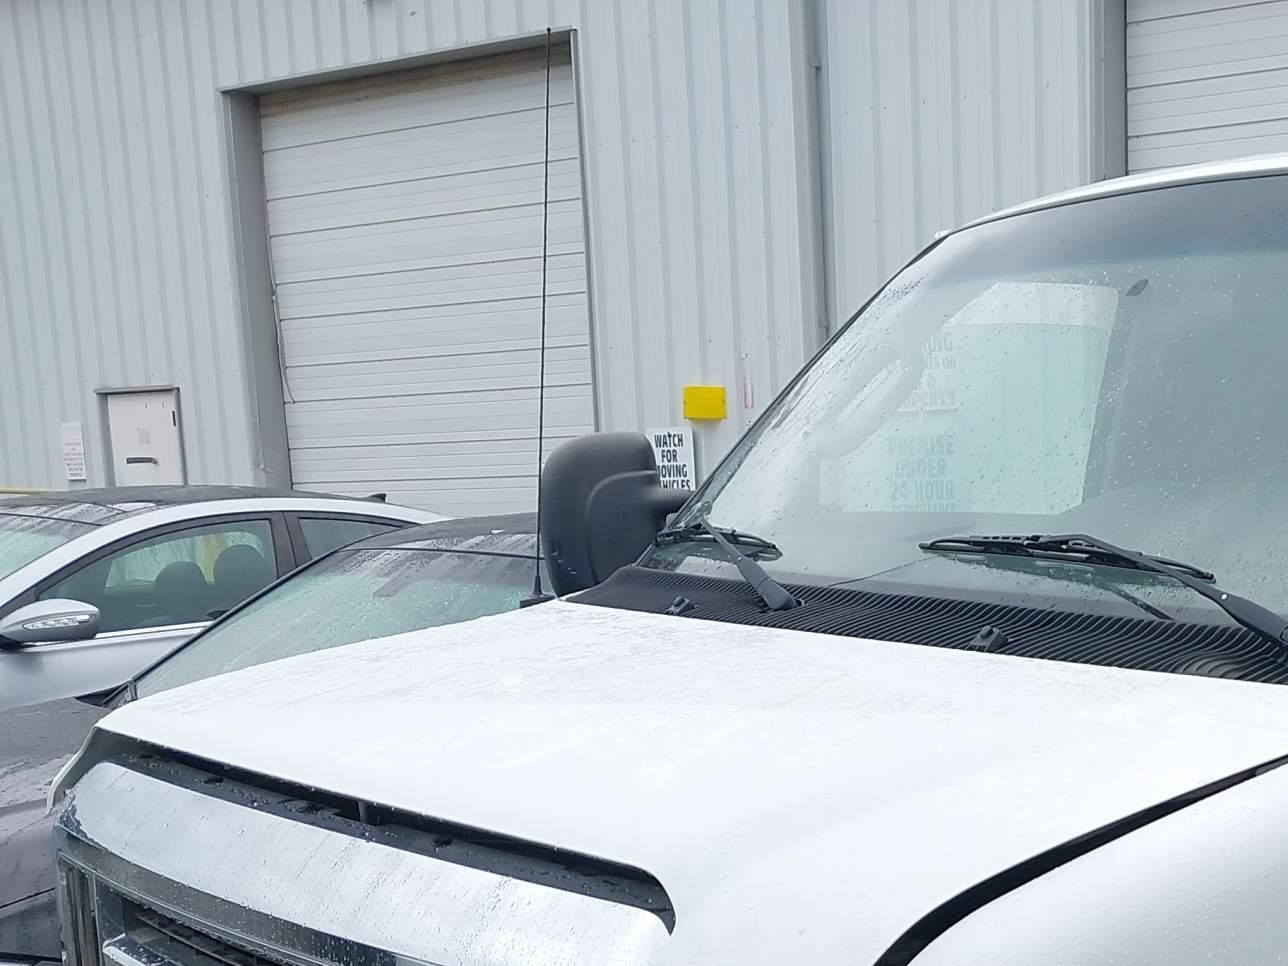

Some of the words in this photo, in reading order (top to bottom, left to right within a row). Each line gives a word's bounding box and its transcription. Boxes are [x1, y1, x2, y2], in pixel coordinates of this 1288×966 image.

[654, 432, 684, 448] WATCH
[661, 449, 678, 463] FOR
[659, 479, 691, 492] HICLES
[914, 479, 955, 501] HOUR
